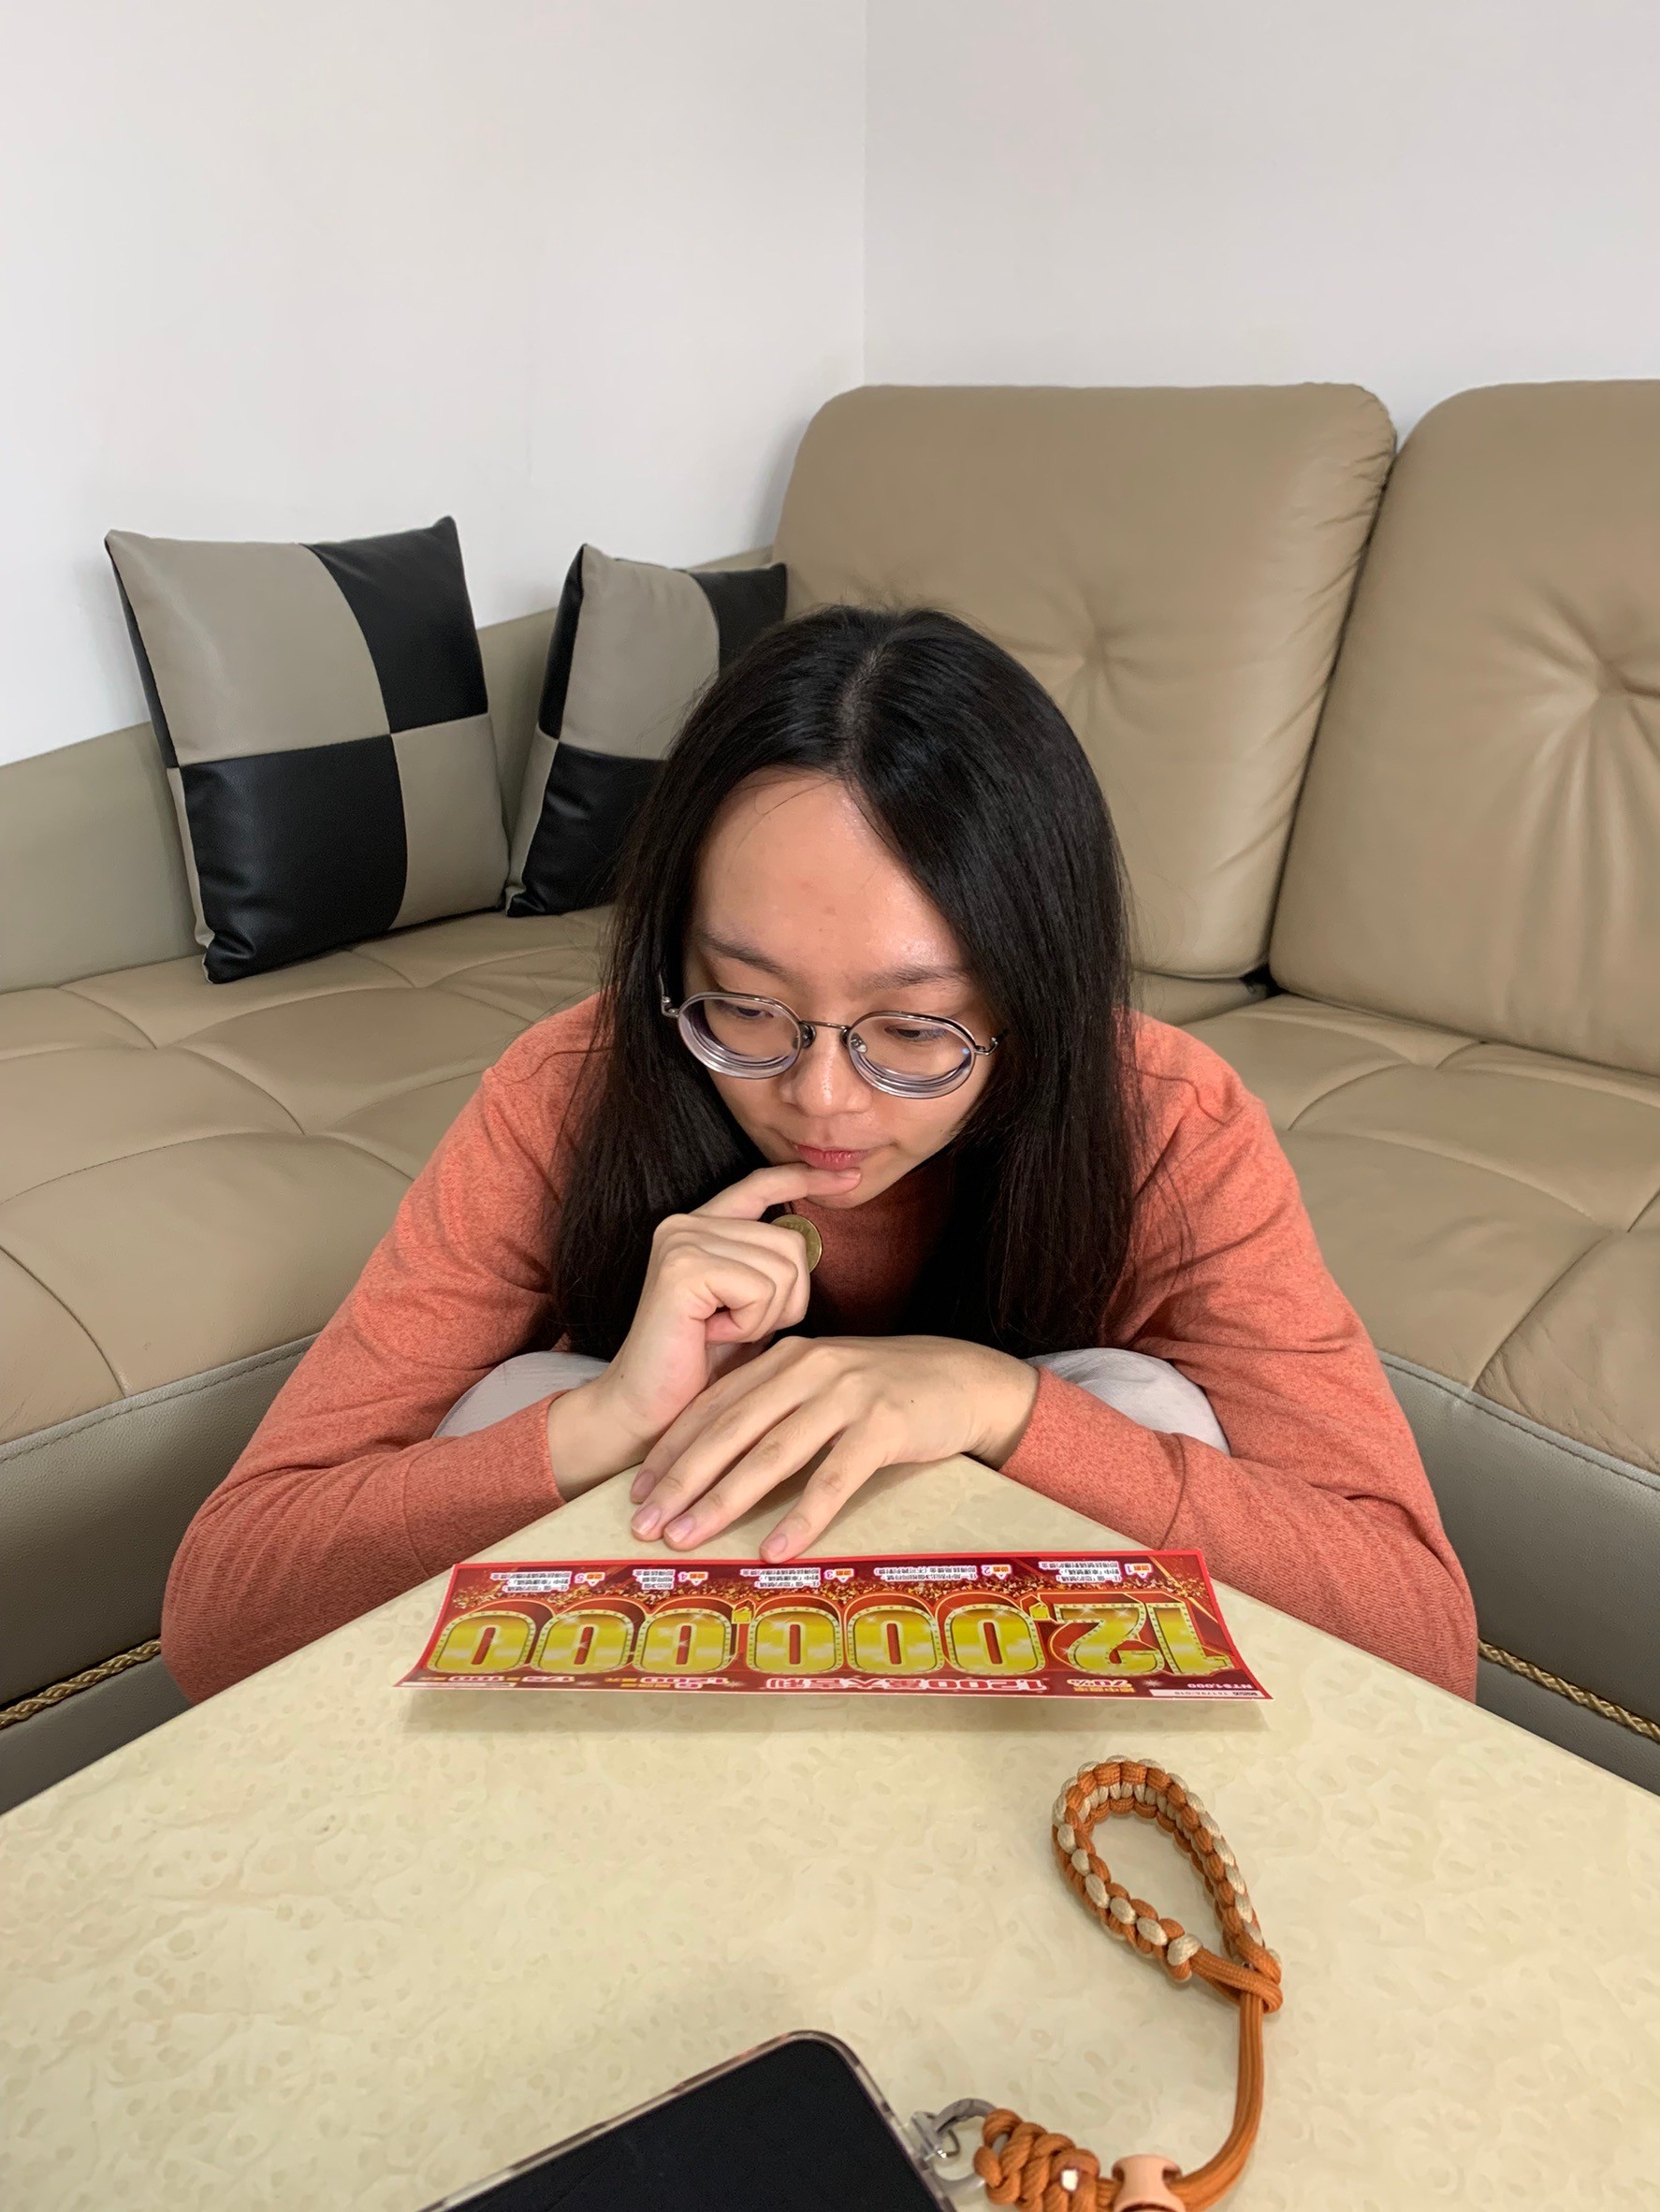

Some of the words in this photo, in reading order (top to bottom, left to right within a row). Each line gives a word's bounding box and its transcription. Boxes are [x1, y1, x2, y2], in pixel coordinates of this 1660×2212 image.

[427, 1602, 1234, 1676] 12,000,000
[766, 1678, 1046, 1691] 1,200萬大吉利
